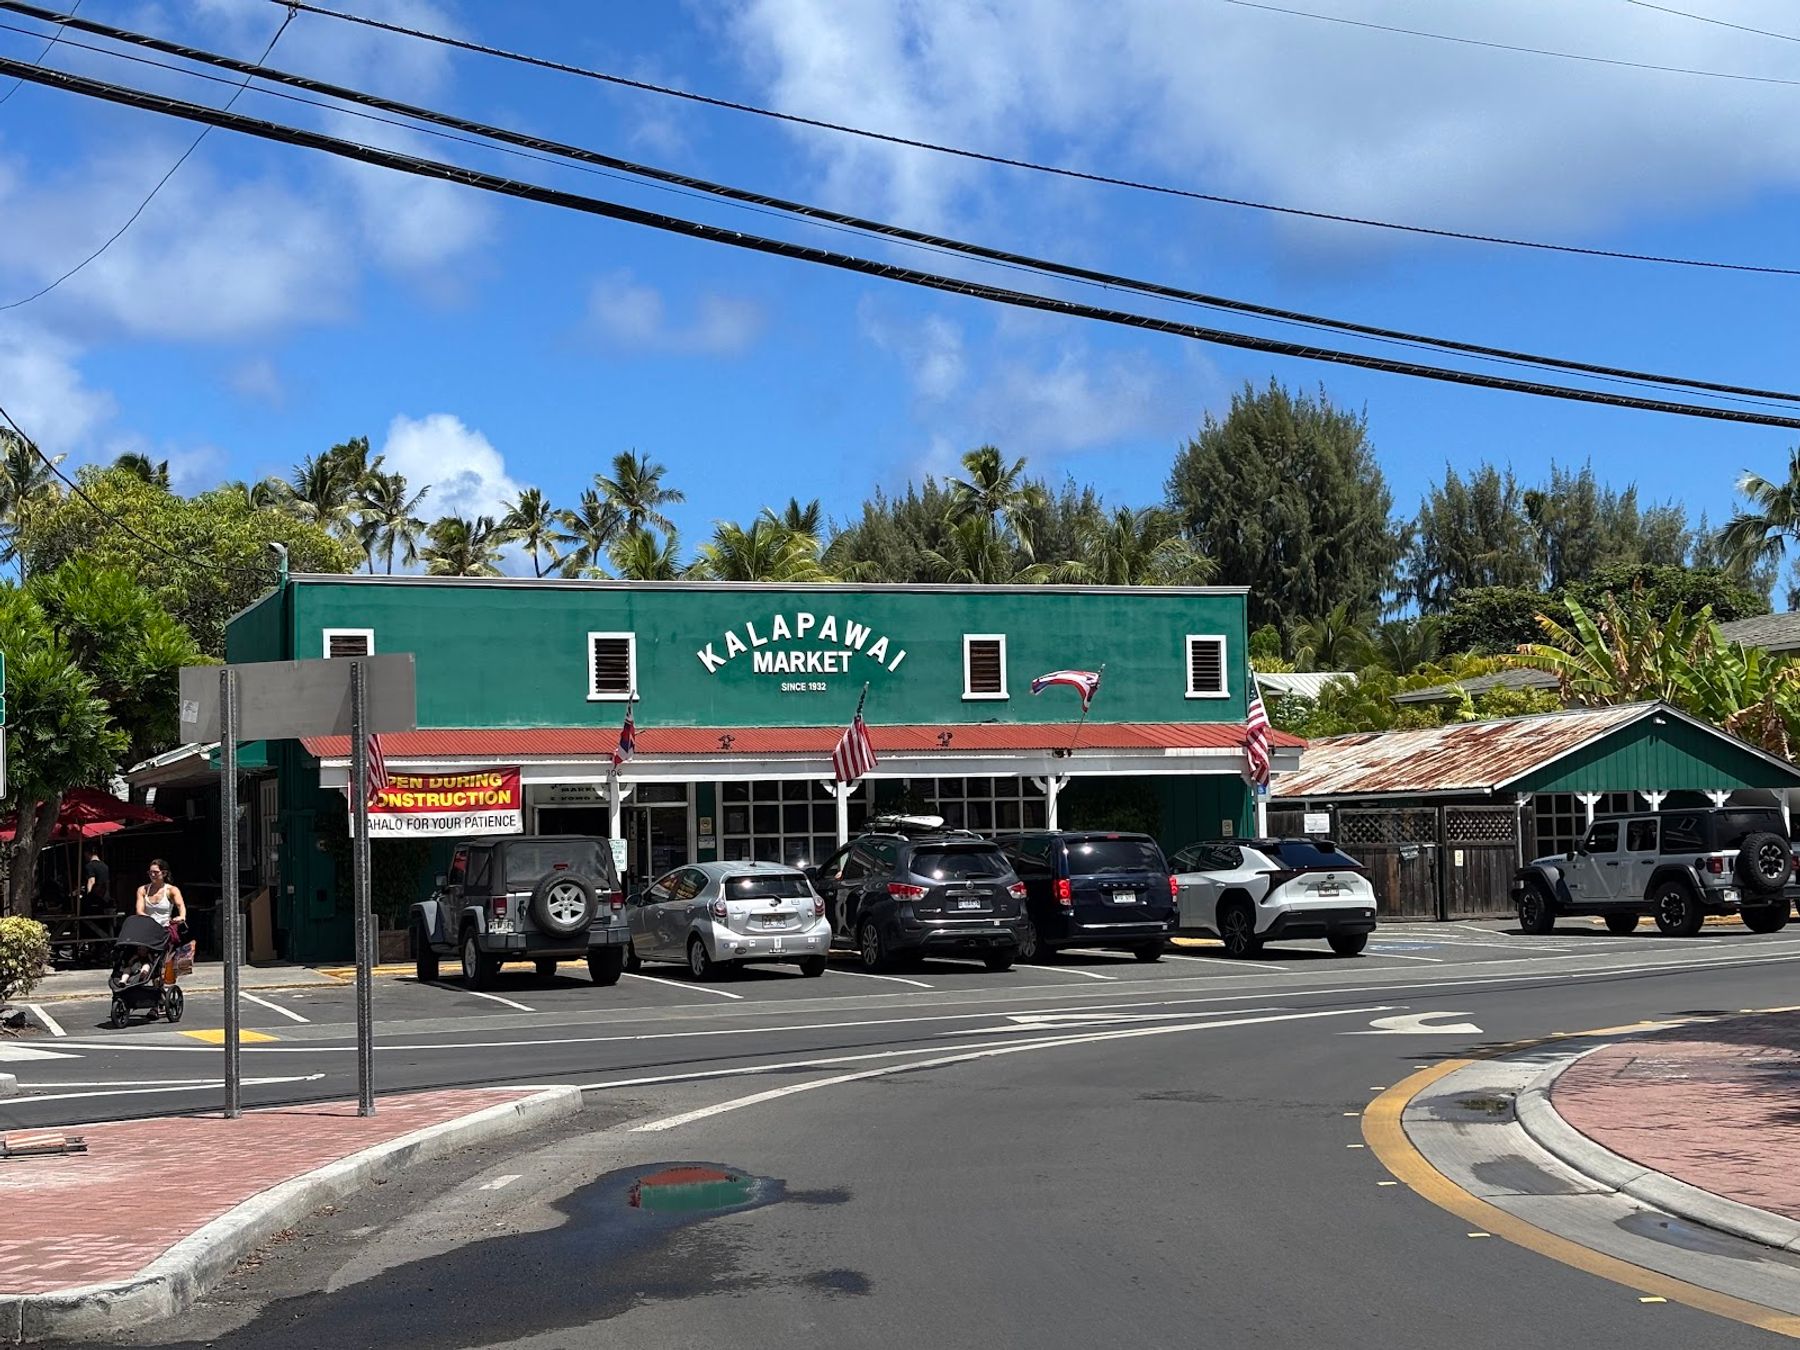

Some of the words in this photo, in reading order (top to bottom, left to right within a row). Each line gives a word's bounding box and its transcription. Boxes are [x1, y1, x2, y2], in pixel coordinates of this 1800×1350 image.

[696, 612, 907, 674] KALAPAWAI
[753, 651, 853, 673] MARKET
[781, 682, 807, 691] SINCE
[808, 682, 827, 691] 1932
[388, 775, 423, 789] PEN
[429, 772, 503, 788] DURING
[367, 790, 511, 807] ONSTRUCTION
[367, 818, 403, 831] AHALO
[407, 818, 429, 830] FOR
[433, 816, 462, 829] YOUR
[464, 814, 516, 828] PATIENCE
